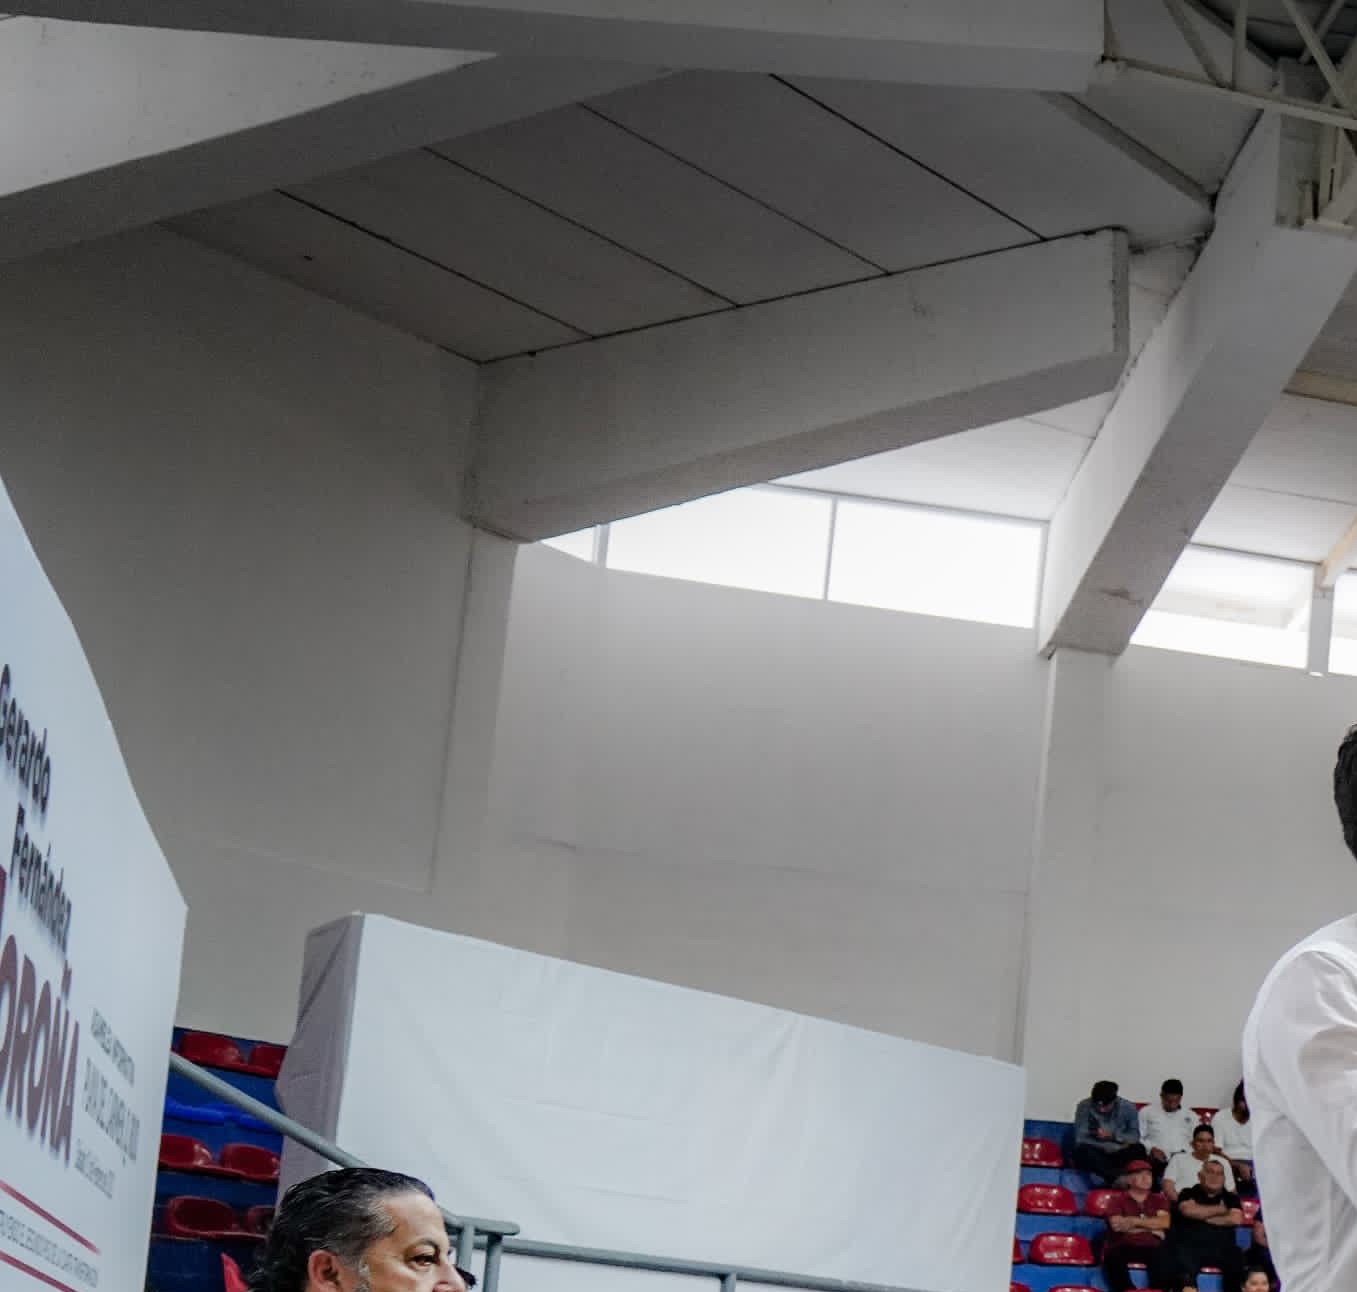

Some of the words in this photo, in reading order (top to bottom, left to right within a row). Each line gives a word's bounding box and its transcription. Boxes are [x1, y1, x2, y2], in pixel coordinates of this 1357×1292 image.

[0, 663, 50, 814] Gerardo
[10, 803, 71, 953] Fernández
[0, 865, 79, 1167] OROÑA
